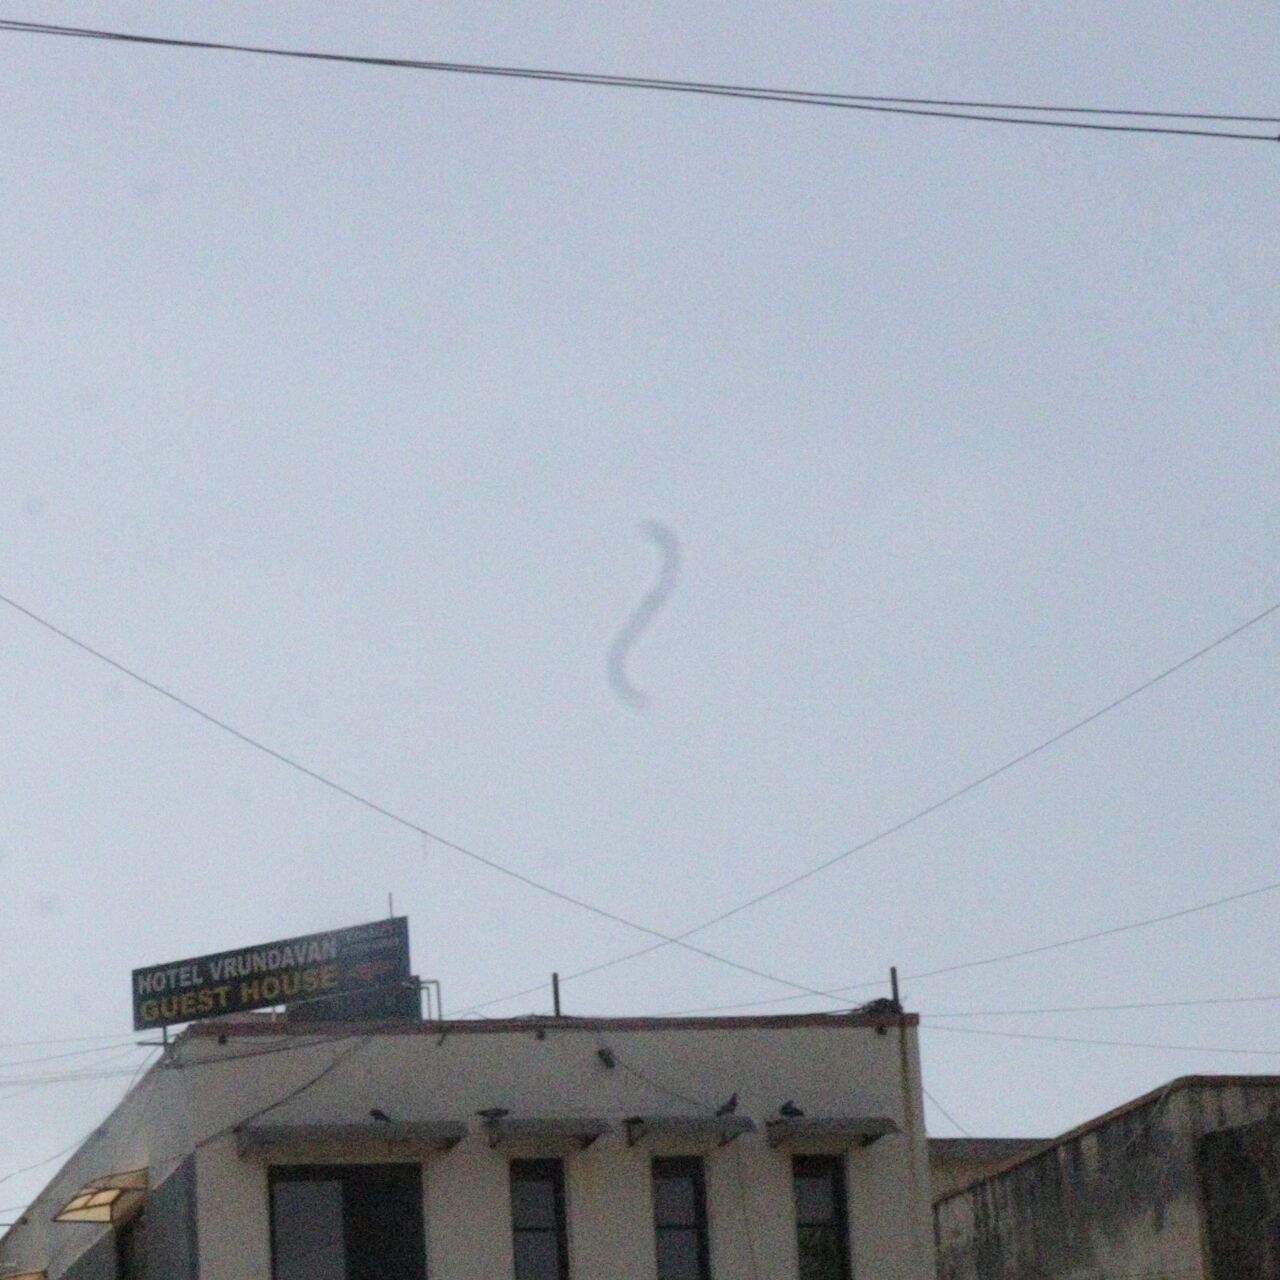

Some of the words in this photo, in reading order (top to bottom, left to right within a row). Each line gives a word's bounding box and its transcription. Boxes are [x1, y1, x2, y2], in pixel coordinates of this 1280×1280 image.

[137, 967, 203, 995] HOTEL
[209, 938, 338, 983] VRUNDAVAN
[143, 986, 230, 1023] GUEST
[240, 965, 339, 1003] HOUSE
